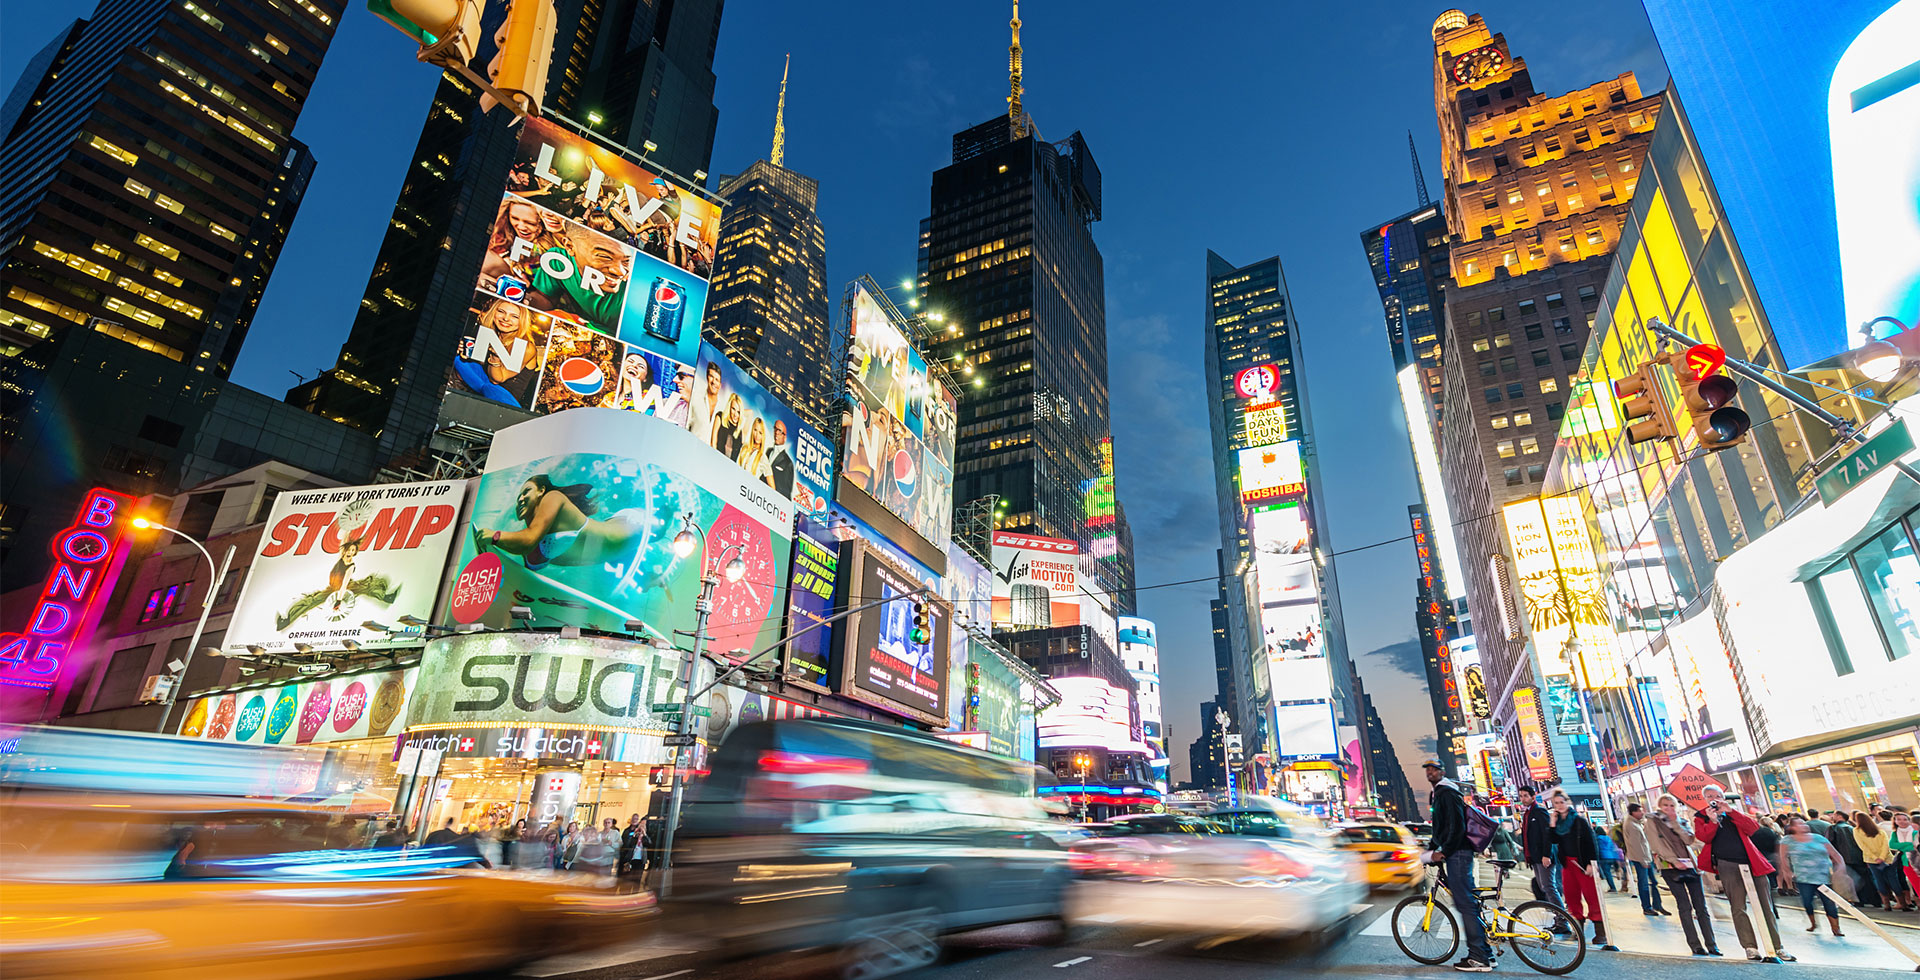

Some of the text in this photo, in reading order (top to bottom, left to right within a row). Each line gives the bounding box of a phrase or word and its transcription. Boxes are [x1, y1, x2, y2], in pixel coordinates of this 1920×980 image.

[534, 142, 703, 250] LIVE
[510, 236, 606, 297] FOR
[650, 304, 660, 329] pepsi
[1617, 318, 1645, 374] THE
[1245, 400, 1282, 413] TOSHIBA
[1252, 409, 1278, 420] FALL
[927, 400, 957, 446] FOR
[1254, 427, 1280, 438] FUN
[799, 428, 832, 458] CATCH EVERY
[796, 436, 832, 481] EPIC
[1838, 449, 1878, 485] 7 Av
[795, 460, 830, 492] MOMENT
[290, 485, 451, 505] WHERE NEW YORK TURNS IT UP
[1243, 483, 1304, 501] TOSHIBA
[739, 484, 780, 520] swatch
[260, 504, 456, 557] STOMP
[1516, 523, 1534, 531] THE
[996, 535, 1075, 551] NITTO
[1515, 533, 1542, 546] LION
[798, 537, 838, 573] TURTLES
[1516, 546, 1548, 560] KING
[31, 496, 117, 636] BOND
[1031, 560, 1074, 572] EXPERIENCE
[459, 566, 500, 588] PUSH
[1031, 569, 1075, 584] MOTIVO
[457, 583, 496, 595] THE BUTTON
[1052, 583, 1075, 592] .com
[454, 590, 494, 607] OF FUN
[1413, 518, 1460, 709] ERNST & YOUNG
[288, 629, 361, 639] ORPHEUM THEATRE
[1080, 625, 1088, 659] 1500
[0, 638, 59, 675] 45
[869, 647, 913, 679] PARANORMAL
[339, 693, 365, 707] PUSH
[1514, 695, 1533, 706] BUBBA
[242, 706, 265, 719] PUSH
[334, 710, 361, 722] OF FUN
[237, 721, 260, 733] OF FUN
[496, 735, 588, 754] swatch
[281, 763, 320, 775] PUSH
